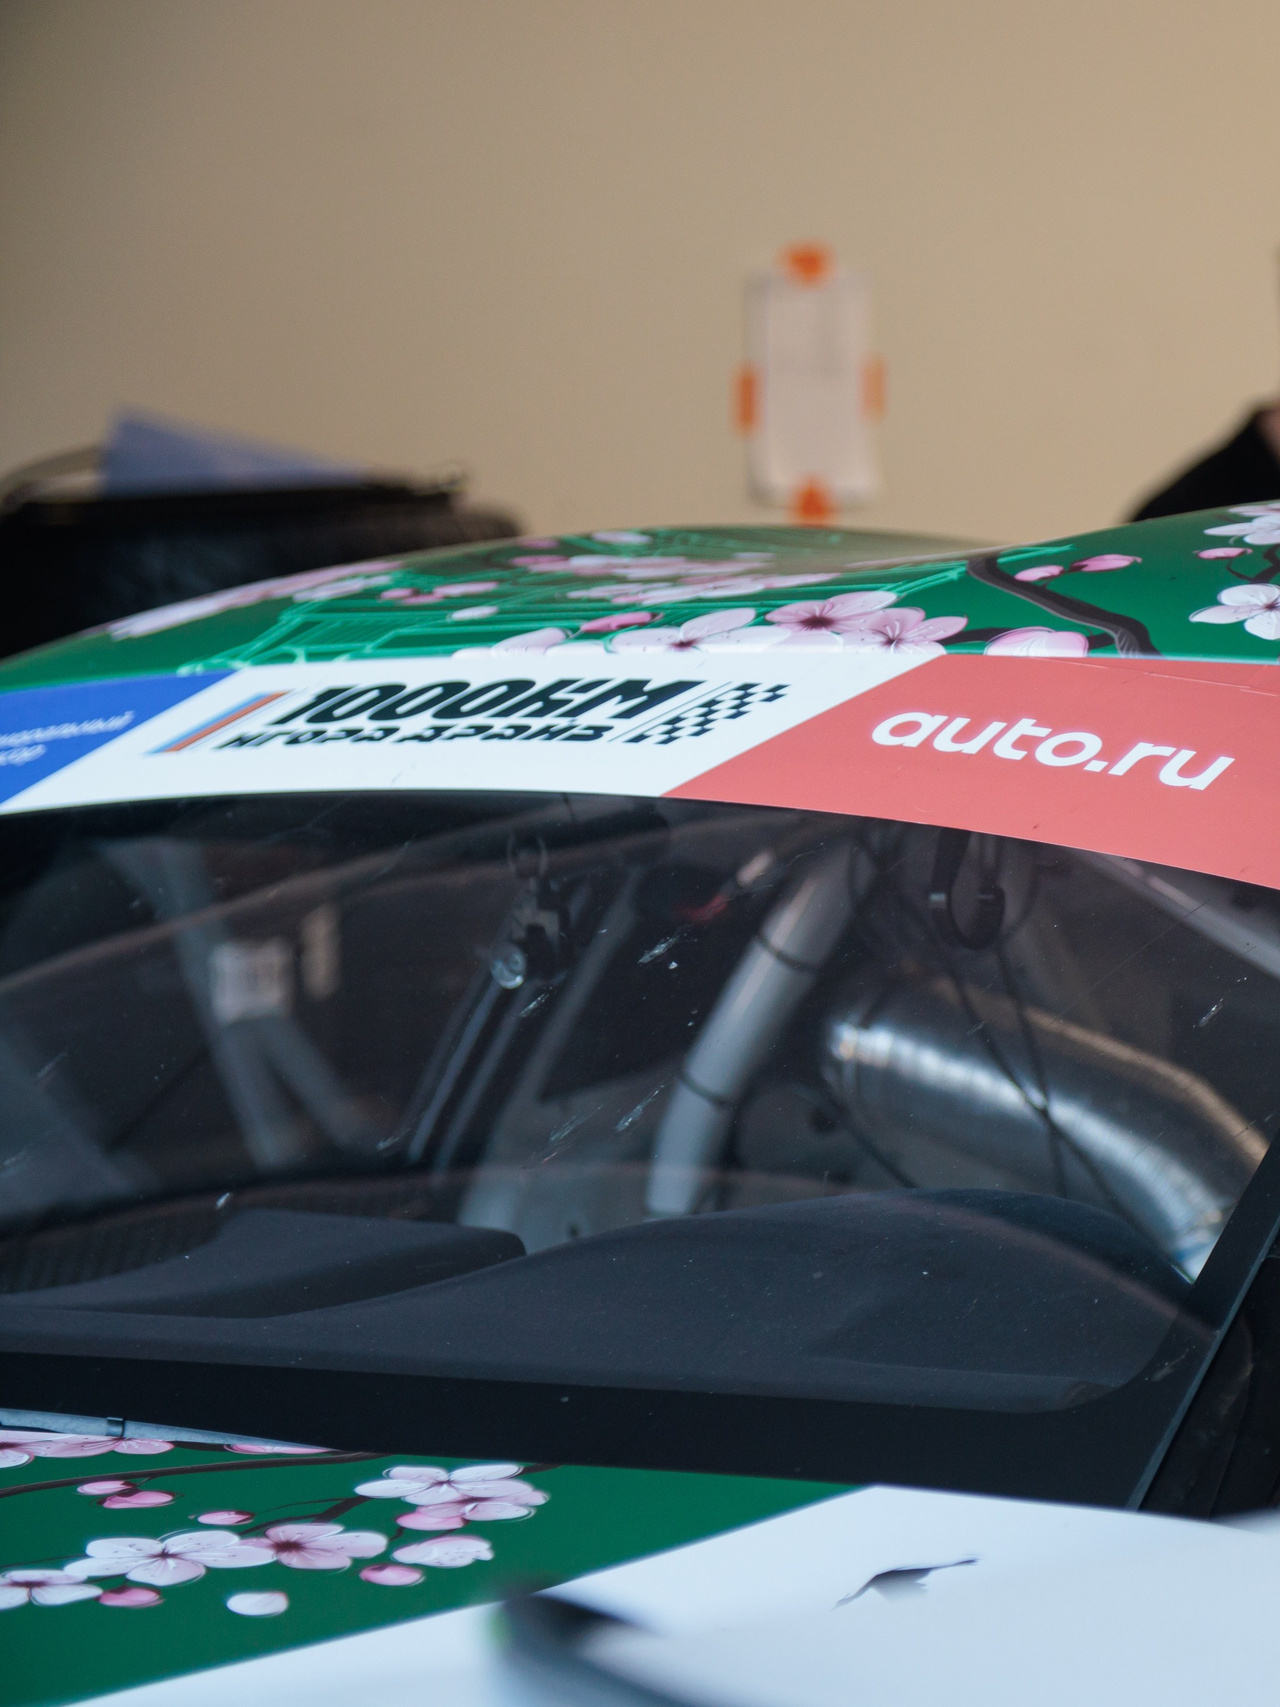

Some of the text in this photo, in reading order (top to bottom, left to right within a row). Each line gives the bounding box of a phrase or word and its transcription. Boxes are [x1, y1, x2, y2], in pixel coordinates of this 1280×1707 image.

[214, 719, 615, 749] ИГОРА ДРАЙВ
[871, 711, 1236, 792] auto.ru
